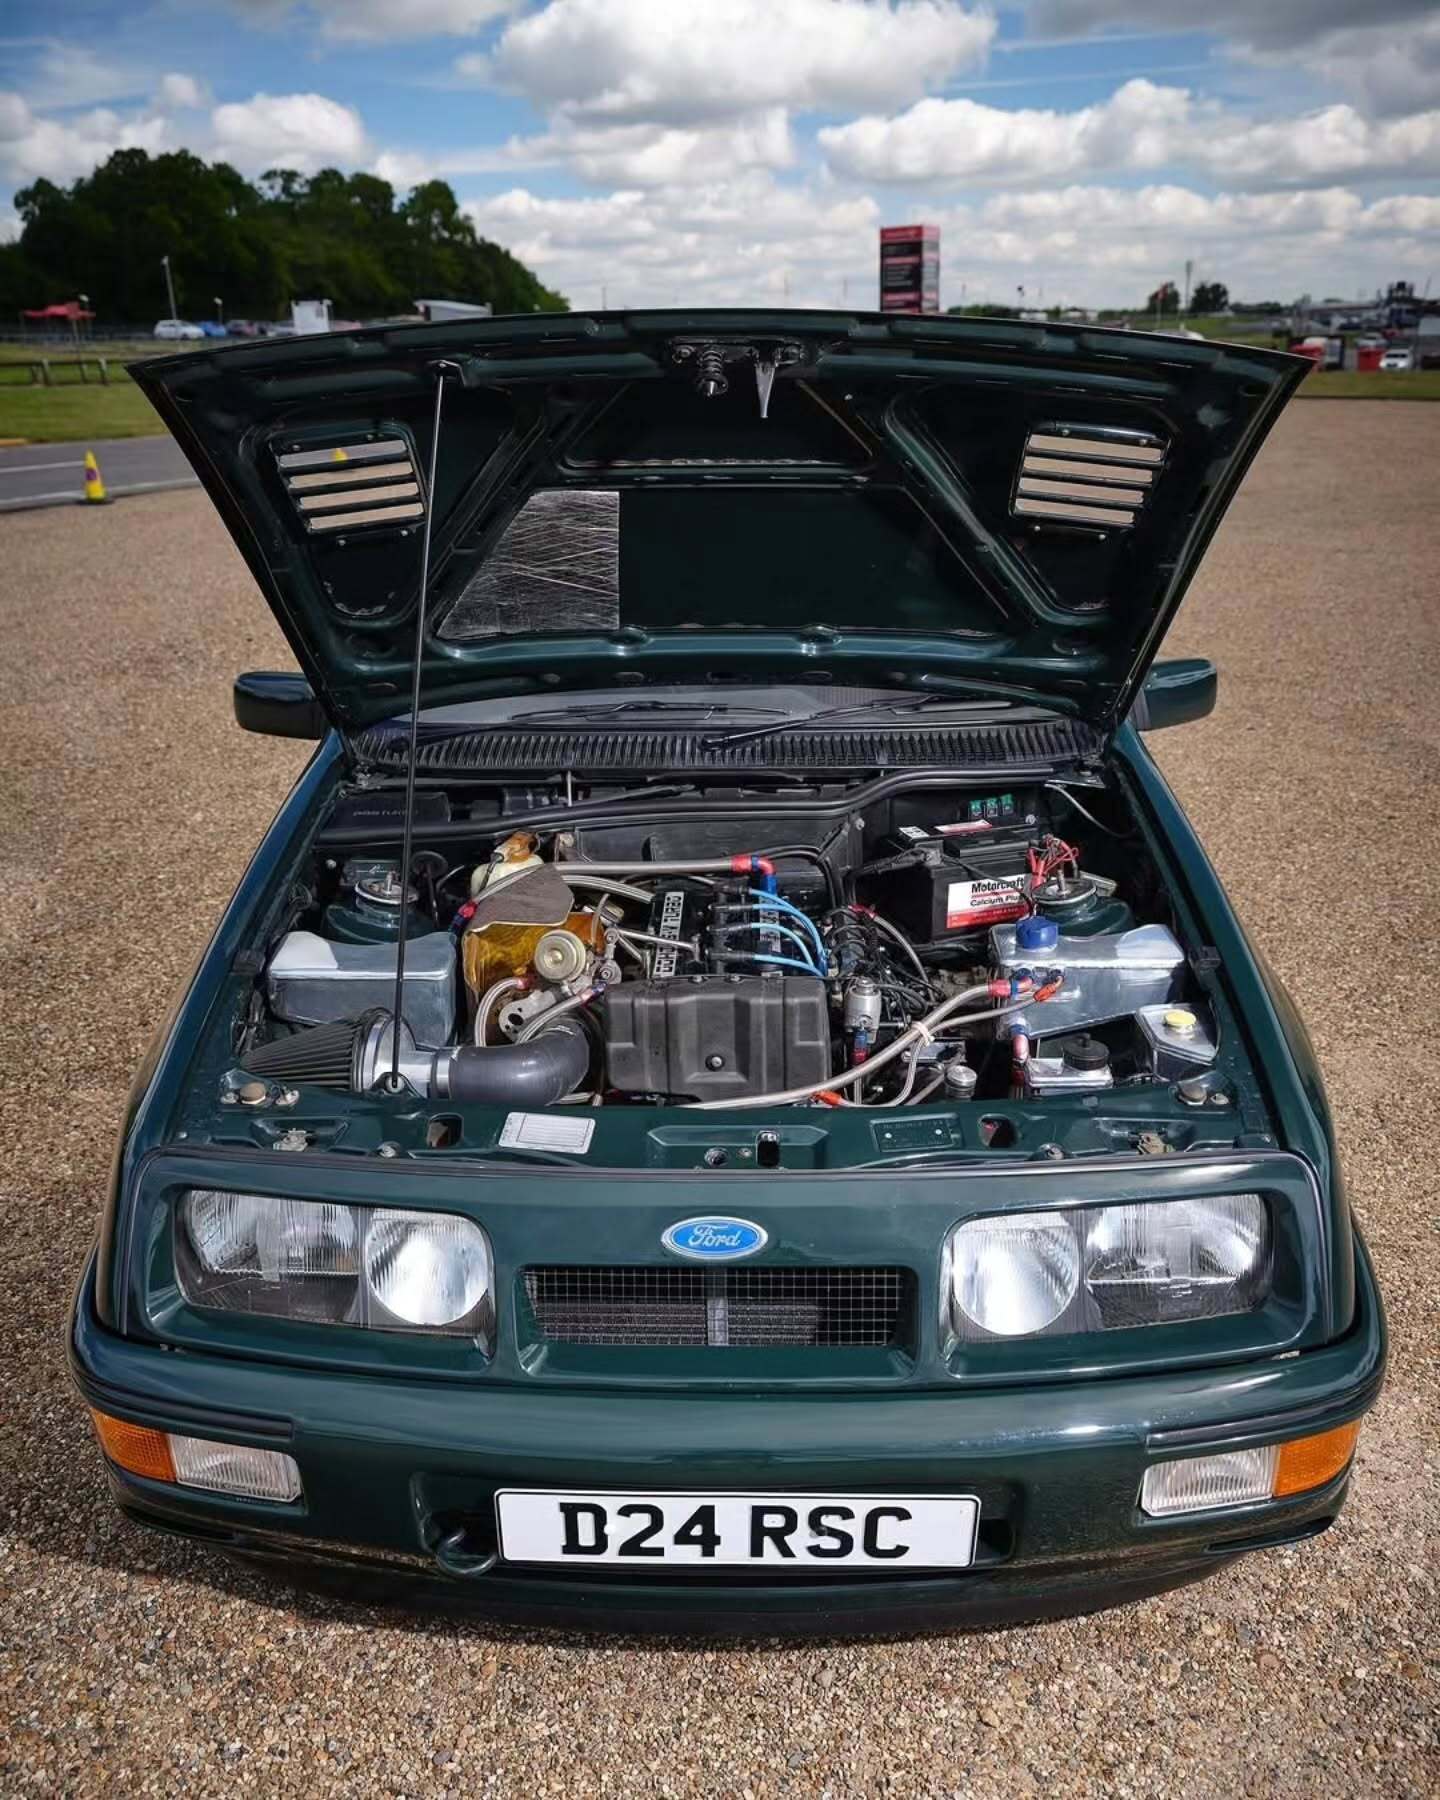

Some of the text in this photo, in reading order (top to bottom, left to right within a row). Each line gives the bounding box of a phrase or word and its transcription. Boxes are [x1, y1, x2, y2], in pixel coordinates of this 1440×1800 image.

[970, 897, 1004, 907] Calcium
[688, 1223, 741, 1247] Ford
[559, 1502, 912, 1559] D24 RSC
